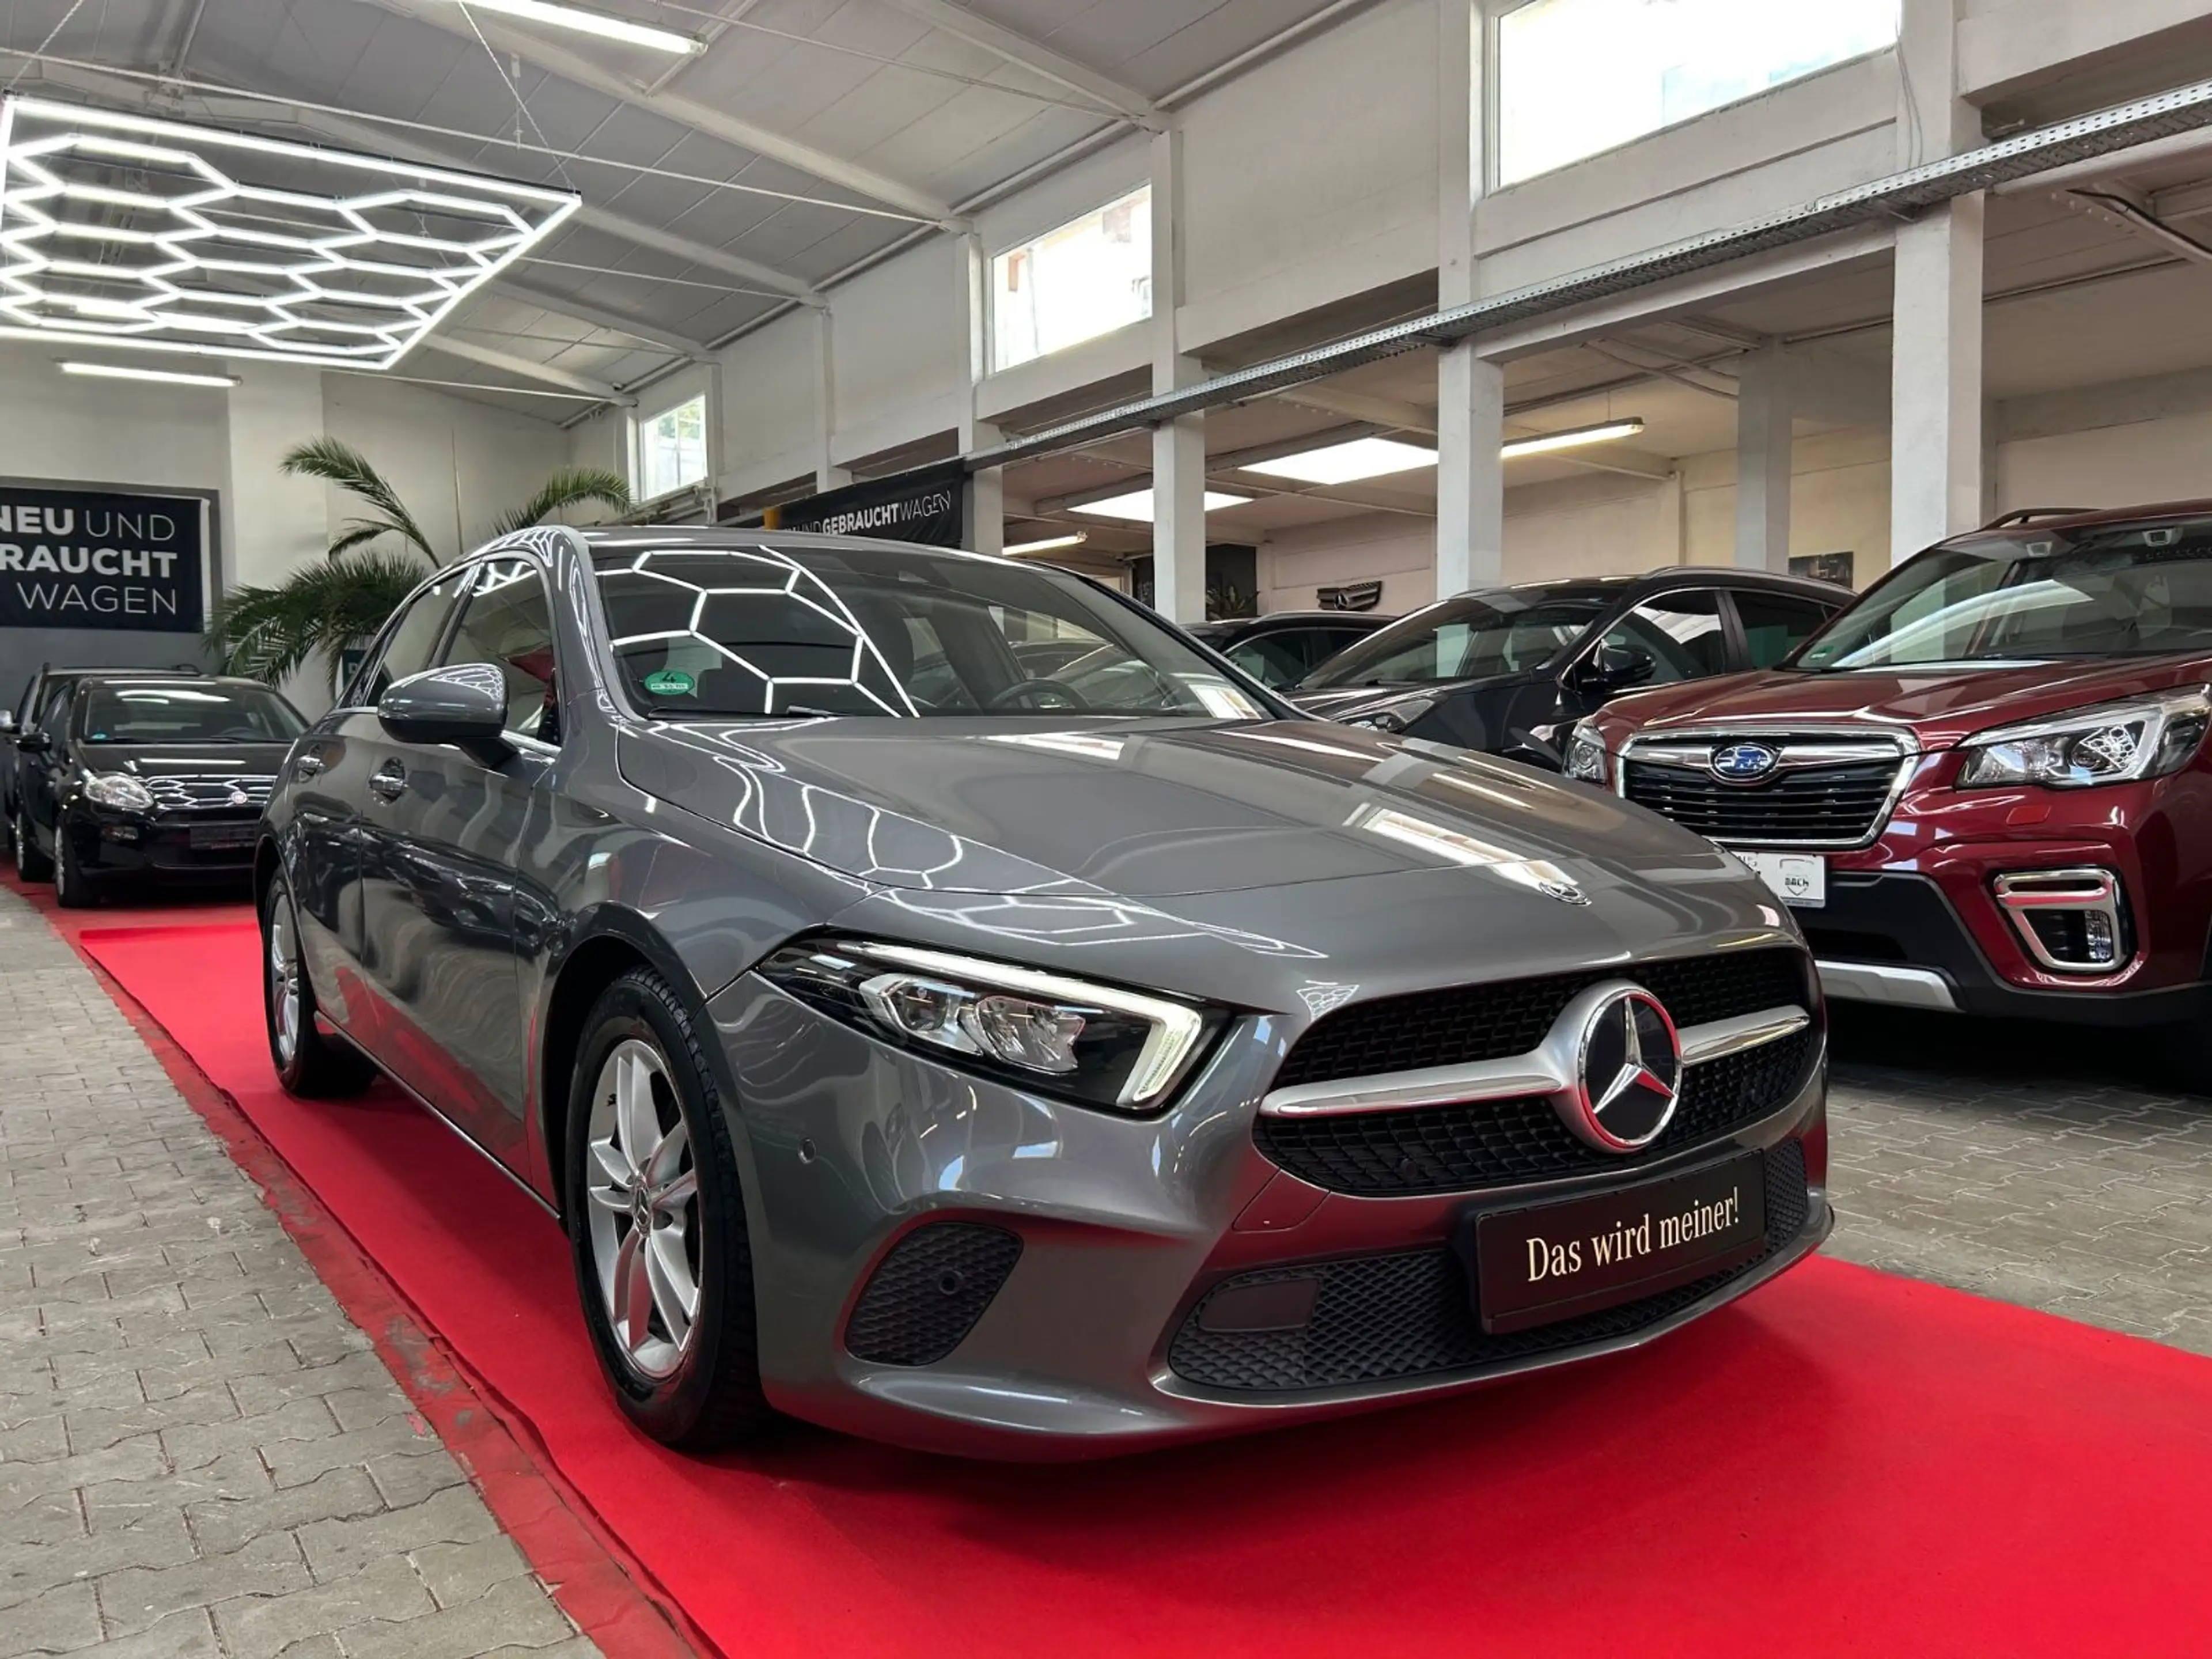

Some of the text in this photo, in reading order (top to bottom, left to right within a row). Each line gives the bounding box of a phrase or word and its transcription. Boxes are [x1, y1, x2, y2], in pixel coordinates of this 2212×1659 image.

[86, 510, 175, 541] UND
[0, 543, 178, 578] RAUCHT
[16, 582, 176, 615] WAGEN
[1526, 1186, 1740, 1282] Das wird meiner!
